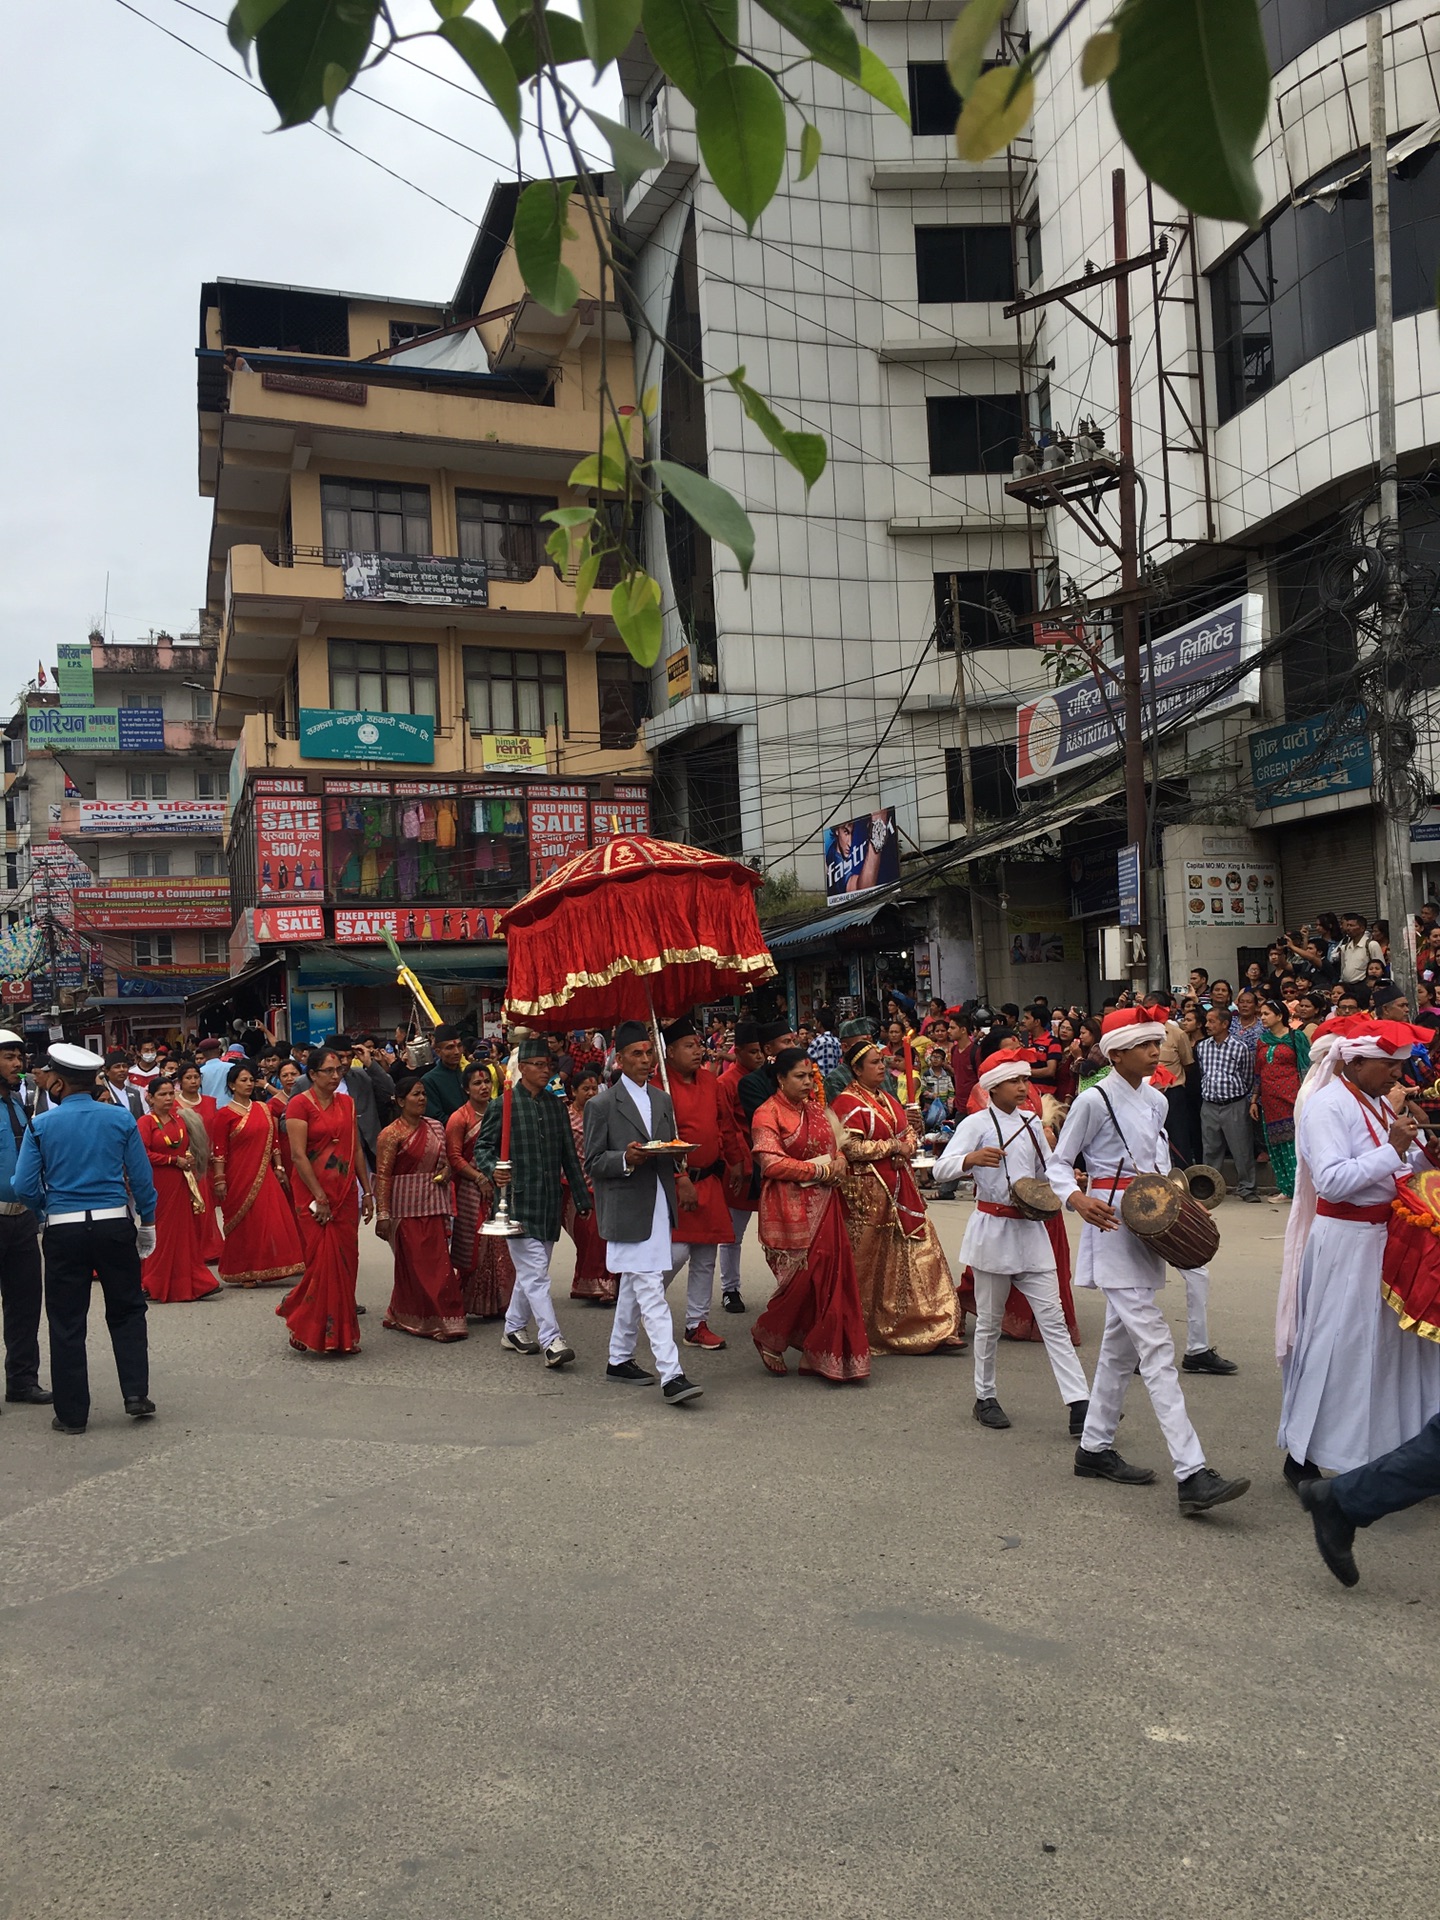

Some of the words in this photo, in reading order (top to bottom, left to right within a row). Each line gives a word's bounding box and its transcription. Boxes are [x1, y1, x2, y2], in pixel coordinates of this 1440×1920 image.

[1179, 622, 1236, 667] लिमिटेड
[29, 709, 87, 734] कोरियन
[88, 715, 117, 726] भाषा
[366, 715, 396, 727] सहकारी
[495, 737, 518, 746] himal
[496, 744, 532, 755] remit
[1256, 761, 1289, 781] GREEN
[274, 780, 304, 792] SALE
[350, 782, 390, 794] SALE
[418, 783, 457, 795] SALE
[485, 784, 523, 796] SALE
[549, 786, 586, 797] SALE
[626, 788, 647, 798] SALE
[82, 801, 150, 812] नोटरी
[262, 799, 288, 810] FIXED
[290, 800, 318, 811] PRICE
[532, 804, 555, 813] FIXED
[558, 804, 583, 814] PRICE
[594, 805, 618, 815] FIXED
[620, 806, 646, 815] PRICE
[262, 811, 320, 831] SALE
[531, 814, 586, 833] SALE
[297, 831, 320, 843] मूल्य
[271, 842, 308, 857] 500/-
[541, 843, 574, 857] 500/-
[1186, 862, 1205, 870] Capital
[1228, 862, 1240, 871] King
[105, 890, 155, 899] Language
[166, 889, 217, 898] Computer
[336, 912, 364, 920] FIXED
[367, 911, 397, 920] PRICE
[277, 917, 322, 931] SALE
[336, 920, 398, 935] SALE
